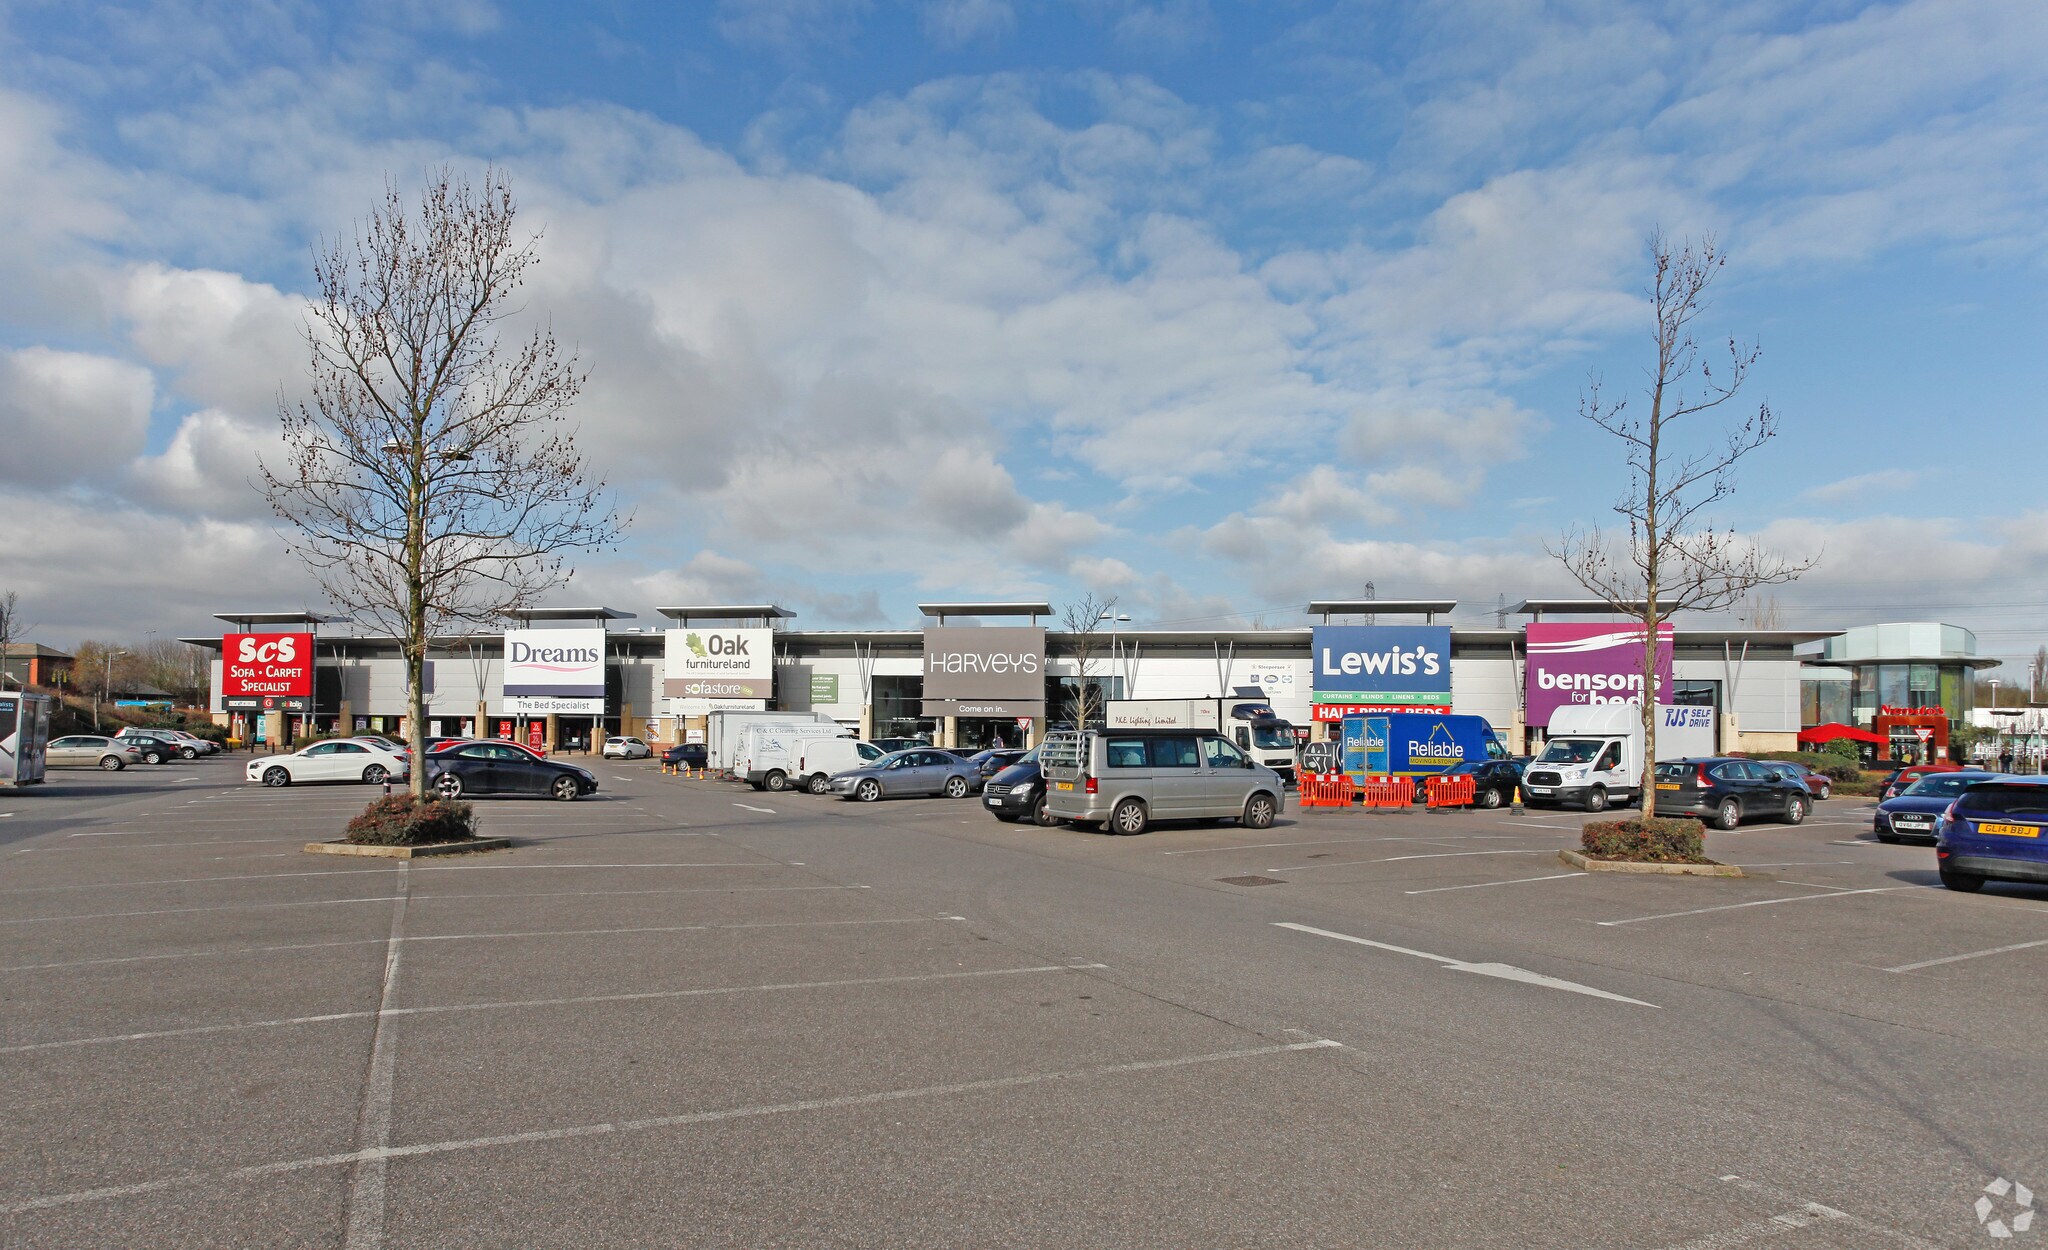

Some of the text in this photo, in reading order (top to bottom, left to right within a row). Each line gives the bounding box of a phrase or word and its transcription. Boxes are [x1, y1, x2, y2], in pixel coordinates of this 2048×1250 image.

[238, 637, 296, 662] ScS
[708, 634, 750, 656] Oak
[510, 642, 598, 662] Dreams
[686, 659, 750, 669] furnitureland
[1322, 646, 1440, 675] Lewis's
[1572, 692, 1588, 702] for
[551, 701, 590, 710] Specialist
[1882, 704, 1944, 716] Nando's
[1665, 708, 1688, 726] TJS
[1691, 709, 1711, 717] SELF
[1130, 716, 1150, 726] Lighting
[1689, 719, 1710, 727] DRIVE
[1347, 737, 1384, 746] Reliable
[1408, 740, 1464, 757] Reliable
[1985, 824, 2008, 833] GL14
